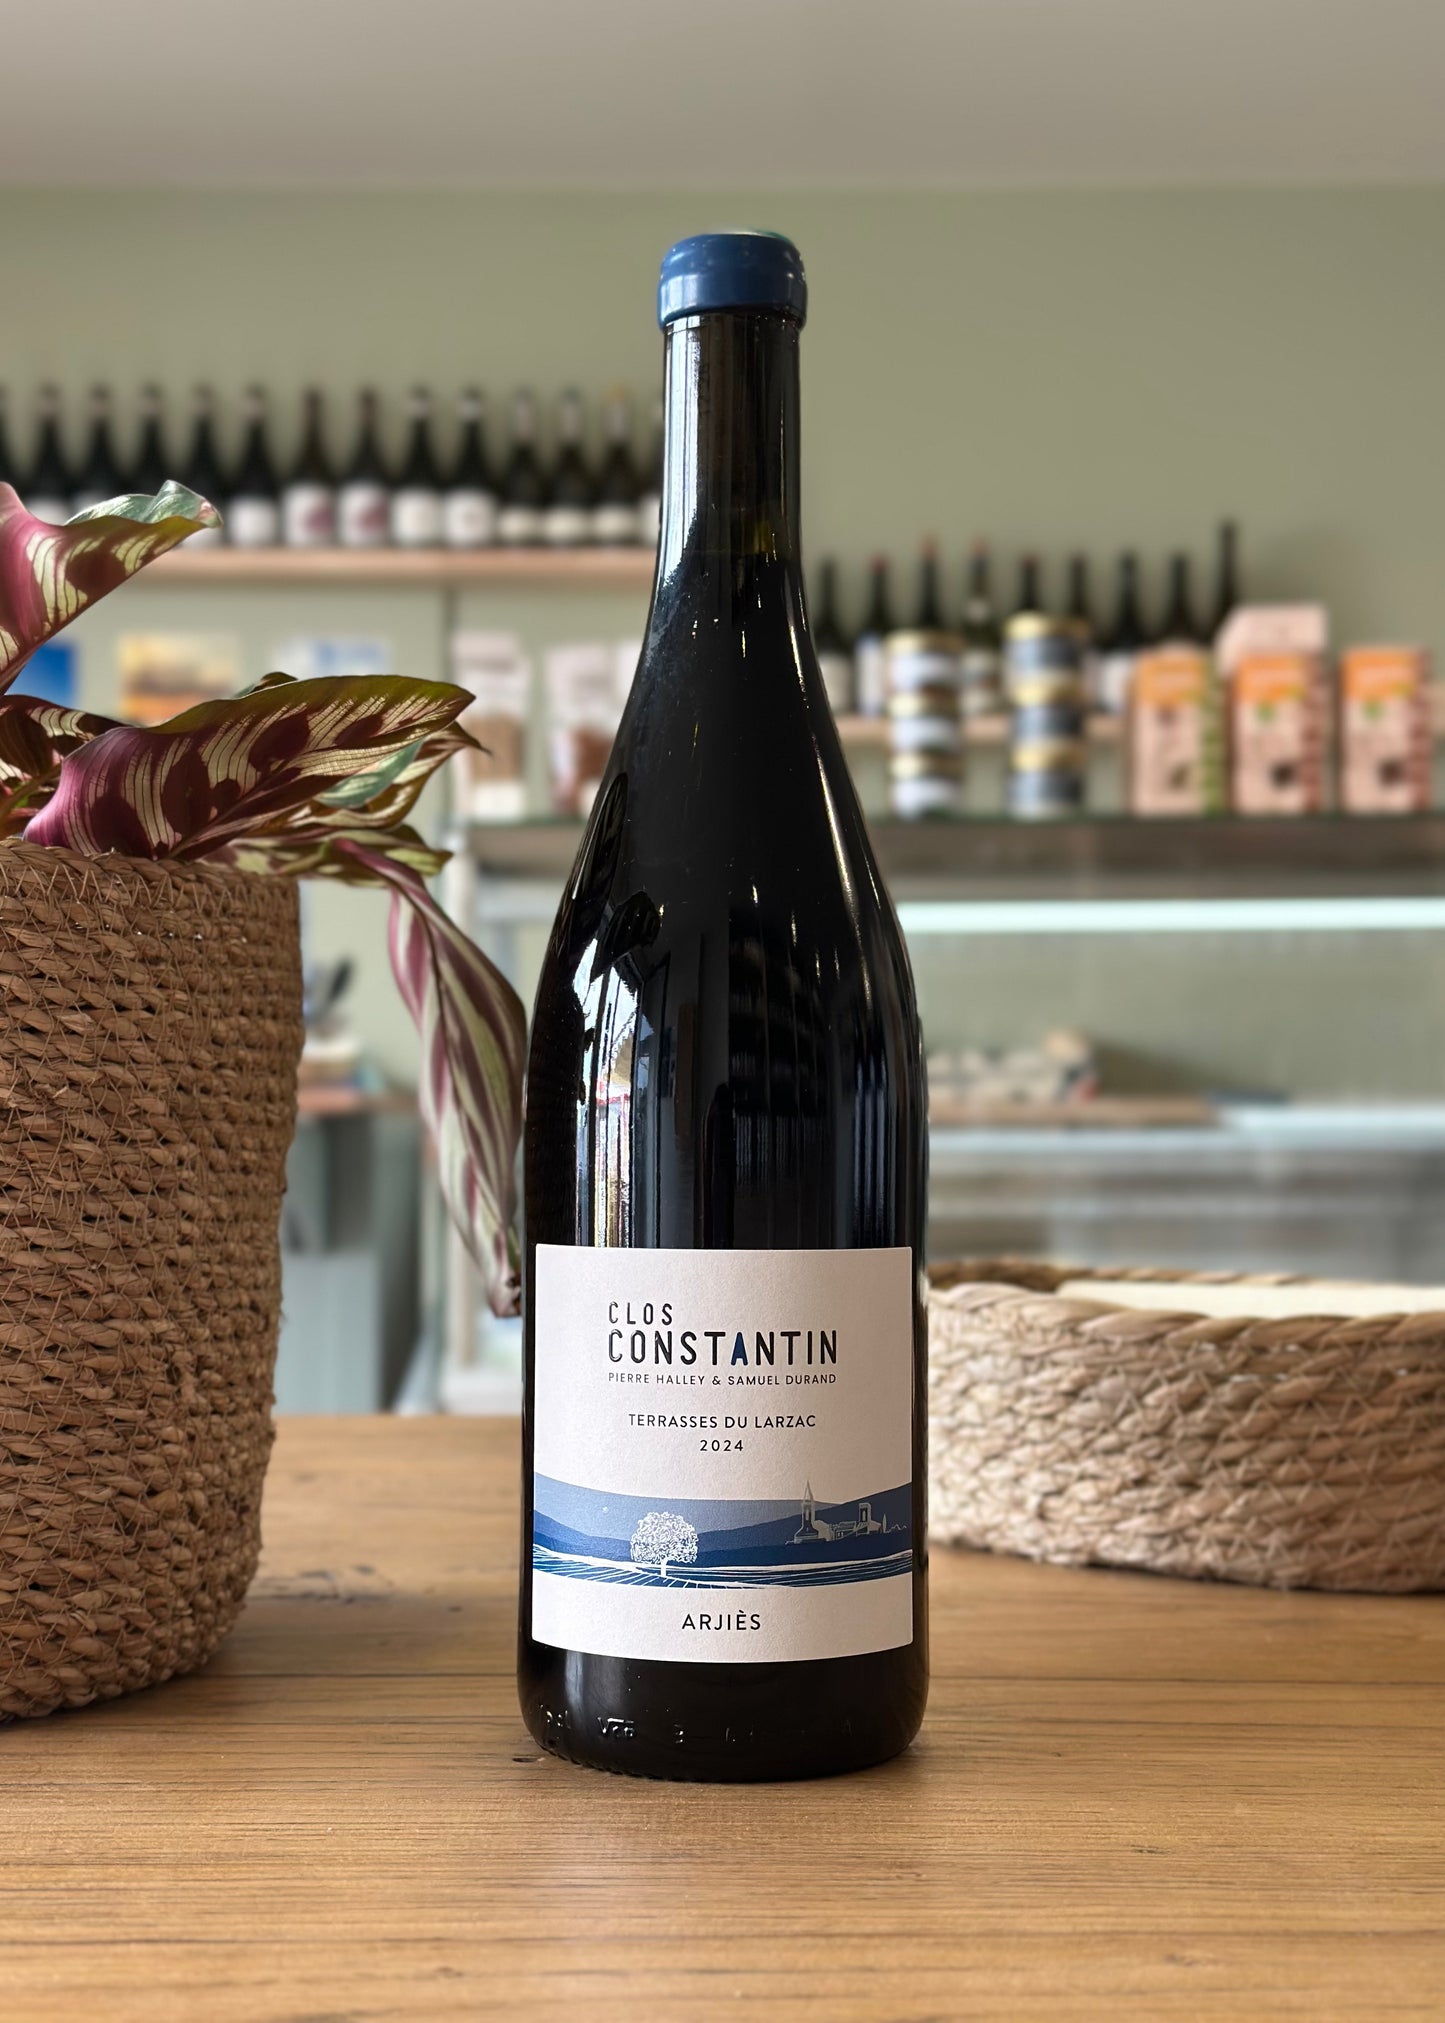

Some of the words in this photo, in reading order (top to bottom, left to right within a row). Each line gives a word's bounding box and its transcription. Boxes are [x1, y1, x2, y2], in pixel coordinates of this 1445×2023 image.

[608, 1301, 673, 1326] CLOS
[608, 1328, 838, 1367] CONSTANTIN
[608, 1372, 650, 1384] PIERRE
[656, 1374, 706, 1386] HALLEY
[711, 1375, 721, 1386] &
[727, 1374, 780, 1386] SAMUEL
[785, 1373, 837, 1386] DURAND
[628, 1413, 718, 1429] TERRASSES
[724, 1415, 748, 1429] DU
[754, 1414, 817, 1429] LARZAC
[699, 1439, 744, 1453] 2024
[681, 1609, 762, 1631] ARJIÈS
